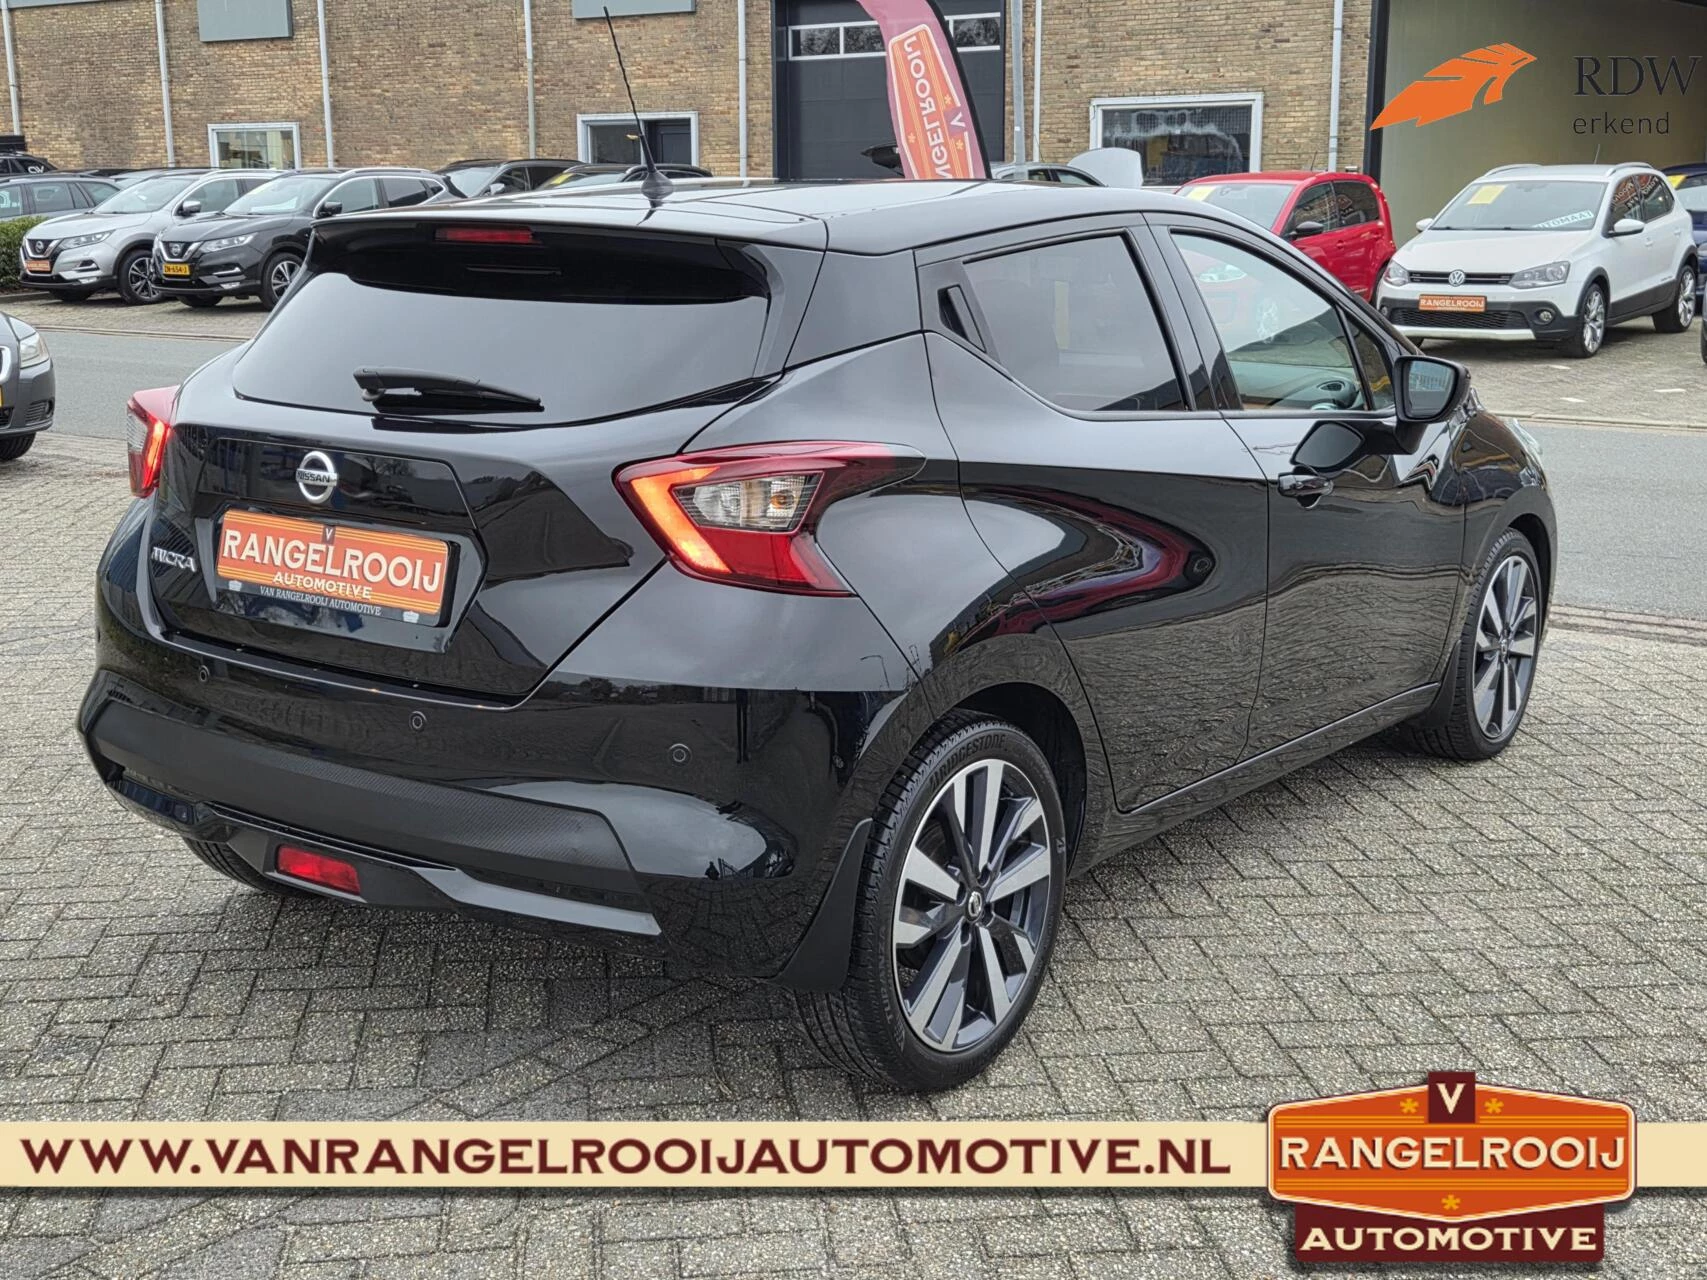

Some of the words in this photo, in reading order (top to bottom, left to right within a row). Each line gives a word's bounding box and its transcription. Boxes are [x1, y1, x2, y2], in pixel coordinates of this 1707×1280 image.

[1420, 298, 1484, 308] RANGELROOIJ
[296, 470, 330, 483] NISSAN
[325, 527, 334, 540] V
[151, 546, 196, 572] MICRA
[222, 529, 442, 593] RANGELROOIJ
[272, 571, 373, 600] AUTOMOTIVE
[260, 586, 275, 596] VAN
[275, 588, 328, 608] RANGELROOIJ
[328, 598, 382, 616] AUTOMOTIVE
